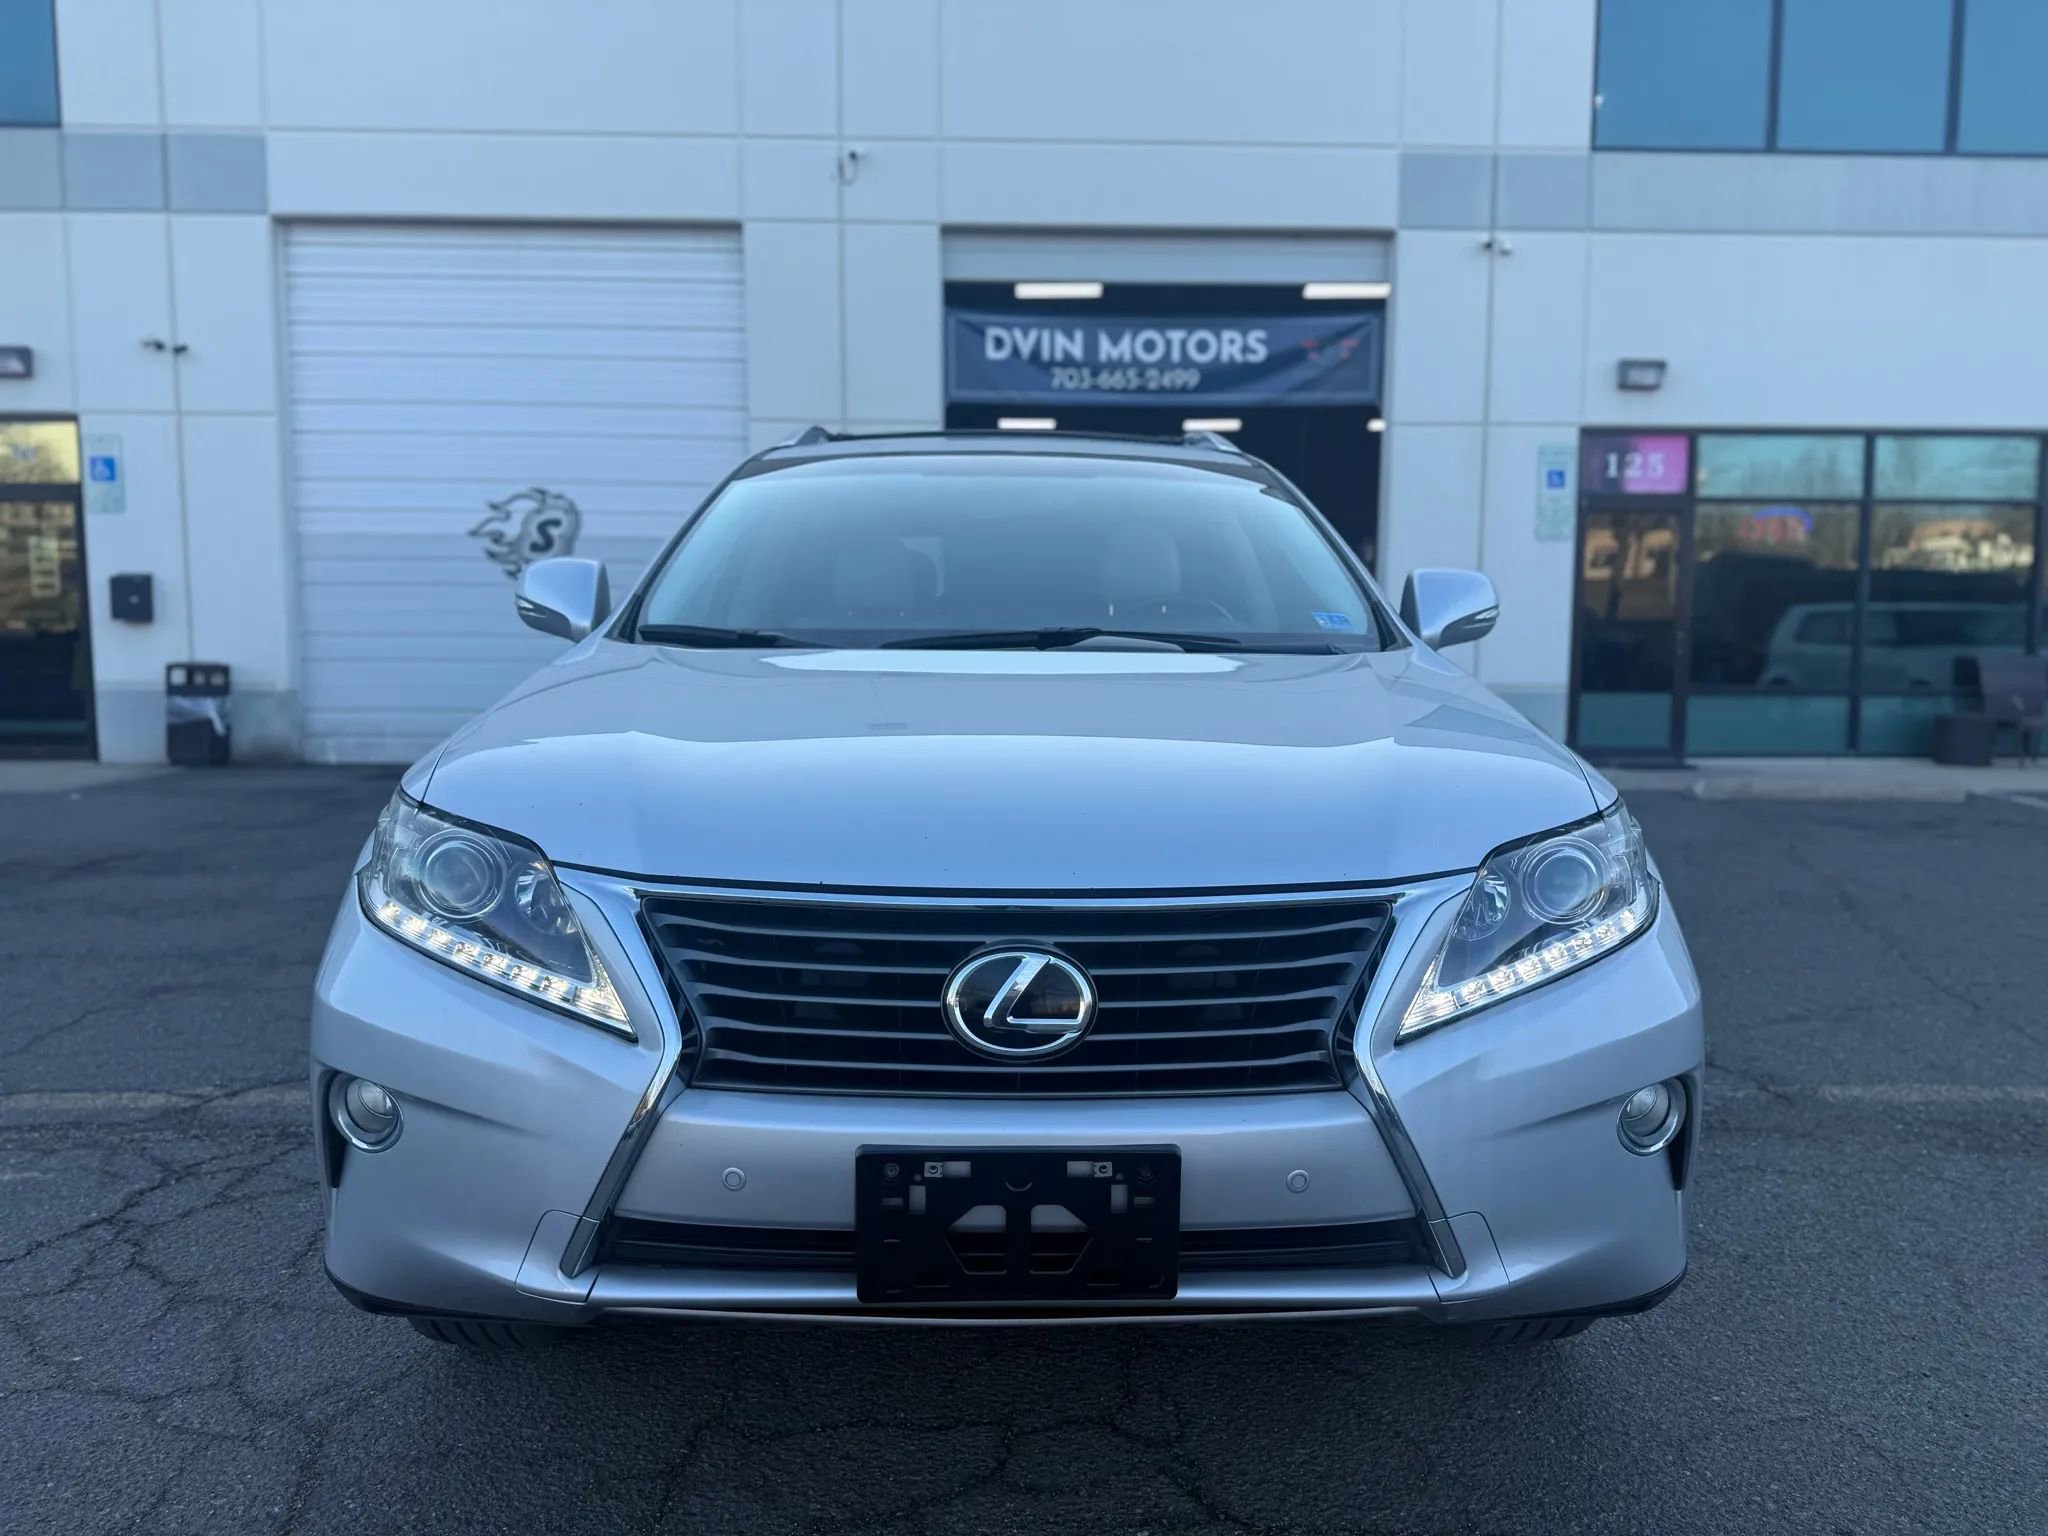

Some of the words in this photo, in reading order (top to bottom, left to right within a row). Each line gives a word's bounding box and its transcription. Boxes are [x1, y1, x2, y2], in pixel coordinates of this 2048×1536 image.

[985, 327, 1084, 361] DVIN
[1098, 329, 1269, 364] MOTORS
[1605, 451, 1666, 480] 125
